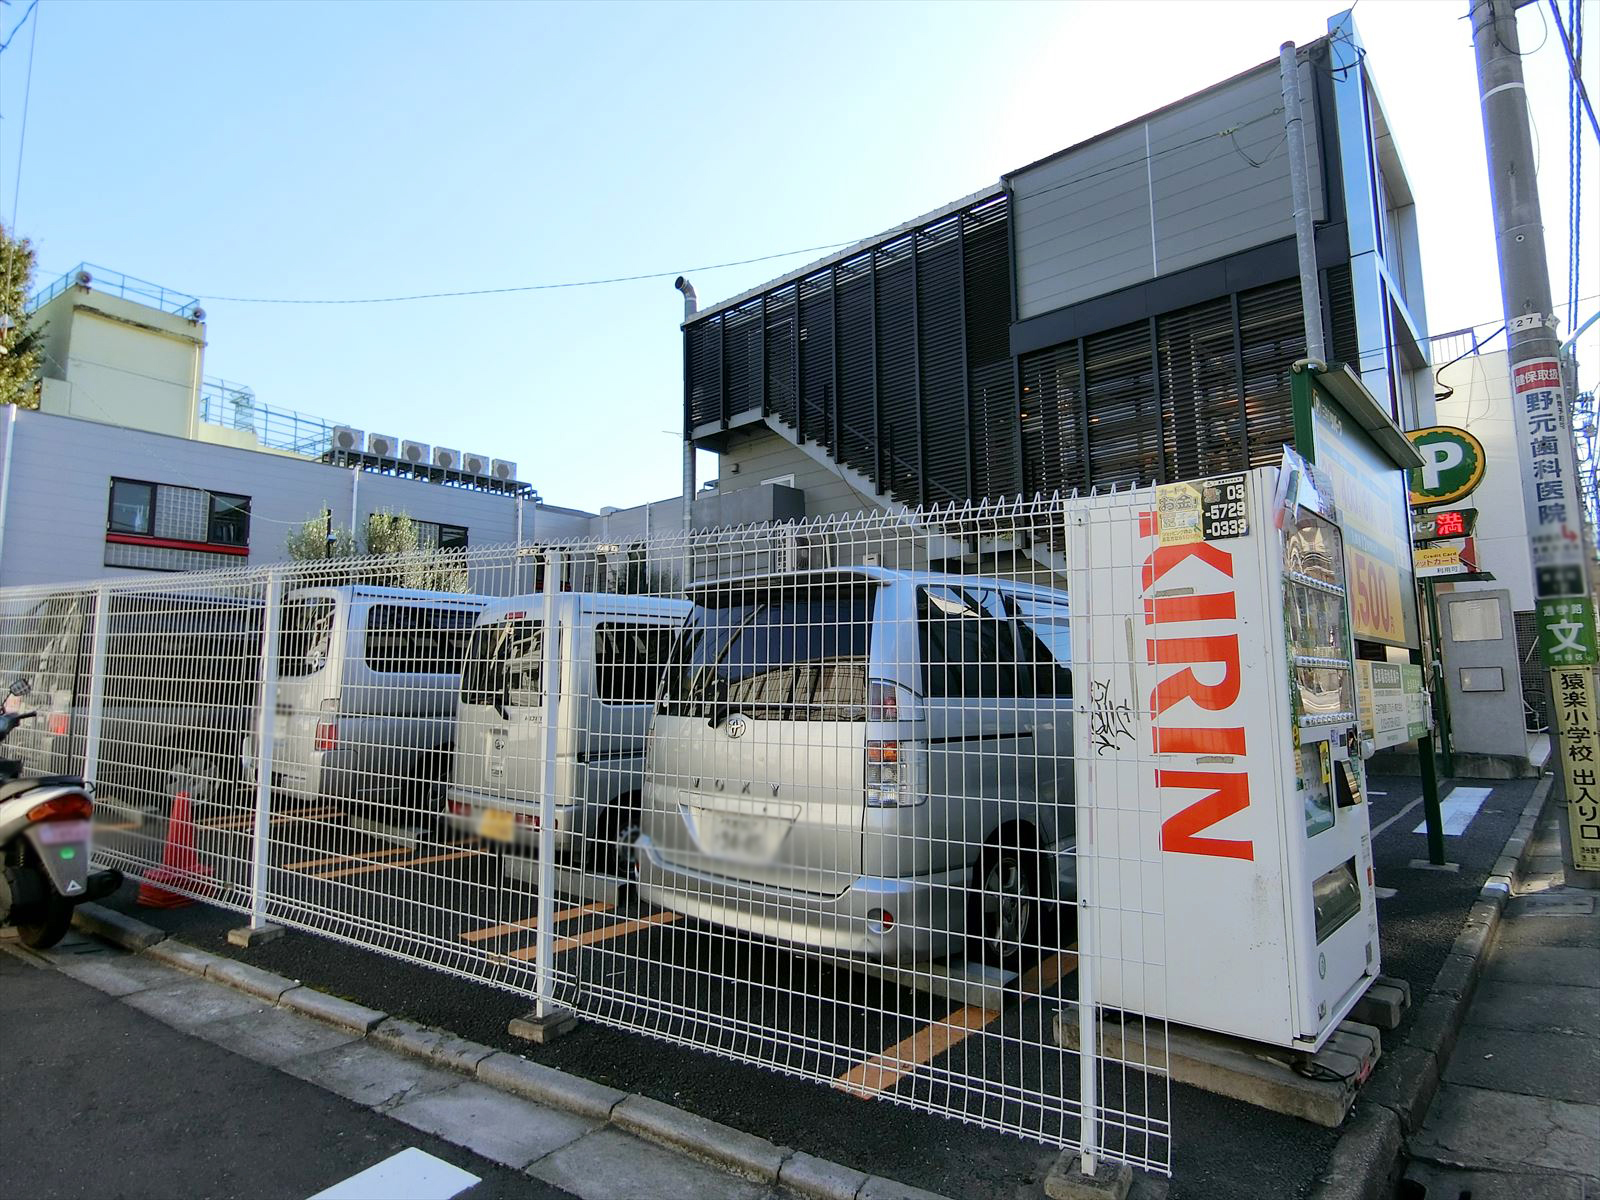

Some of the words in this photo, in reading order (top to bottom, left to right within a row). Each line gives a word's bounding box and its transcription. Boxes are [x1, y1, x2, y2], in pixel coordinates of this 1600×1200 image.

[1516, 317, 1533, 327] 27
[1515, 367, 1559, 388] 健保取扱
[1418, 441, 1463, 490] P
[1525, 390, 1567, 526] 野元歯科医院
[1226, 484, 1244, 500] 03
[1205, 501, 1246, 520] -5729
[1206, 518, 1247, 537] -0333
[1436, 511, 1463, 535] 満
[1138, 511, 1254, 862] KIRIN
[1561, 673, 1593, 762] 猿楽小学校
[691, 777, 780, 797] VOXY
[1573, 769, 1600, 839] 出入り口
